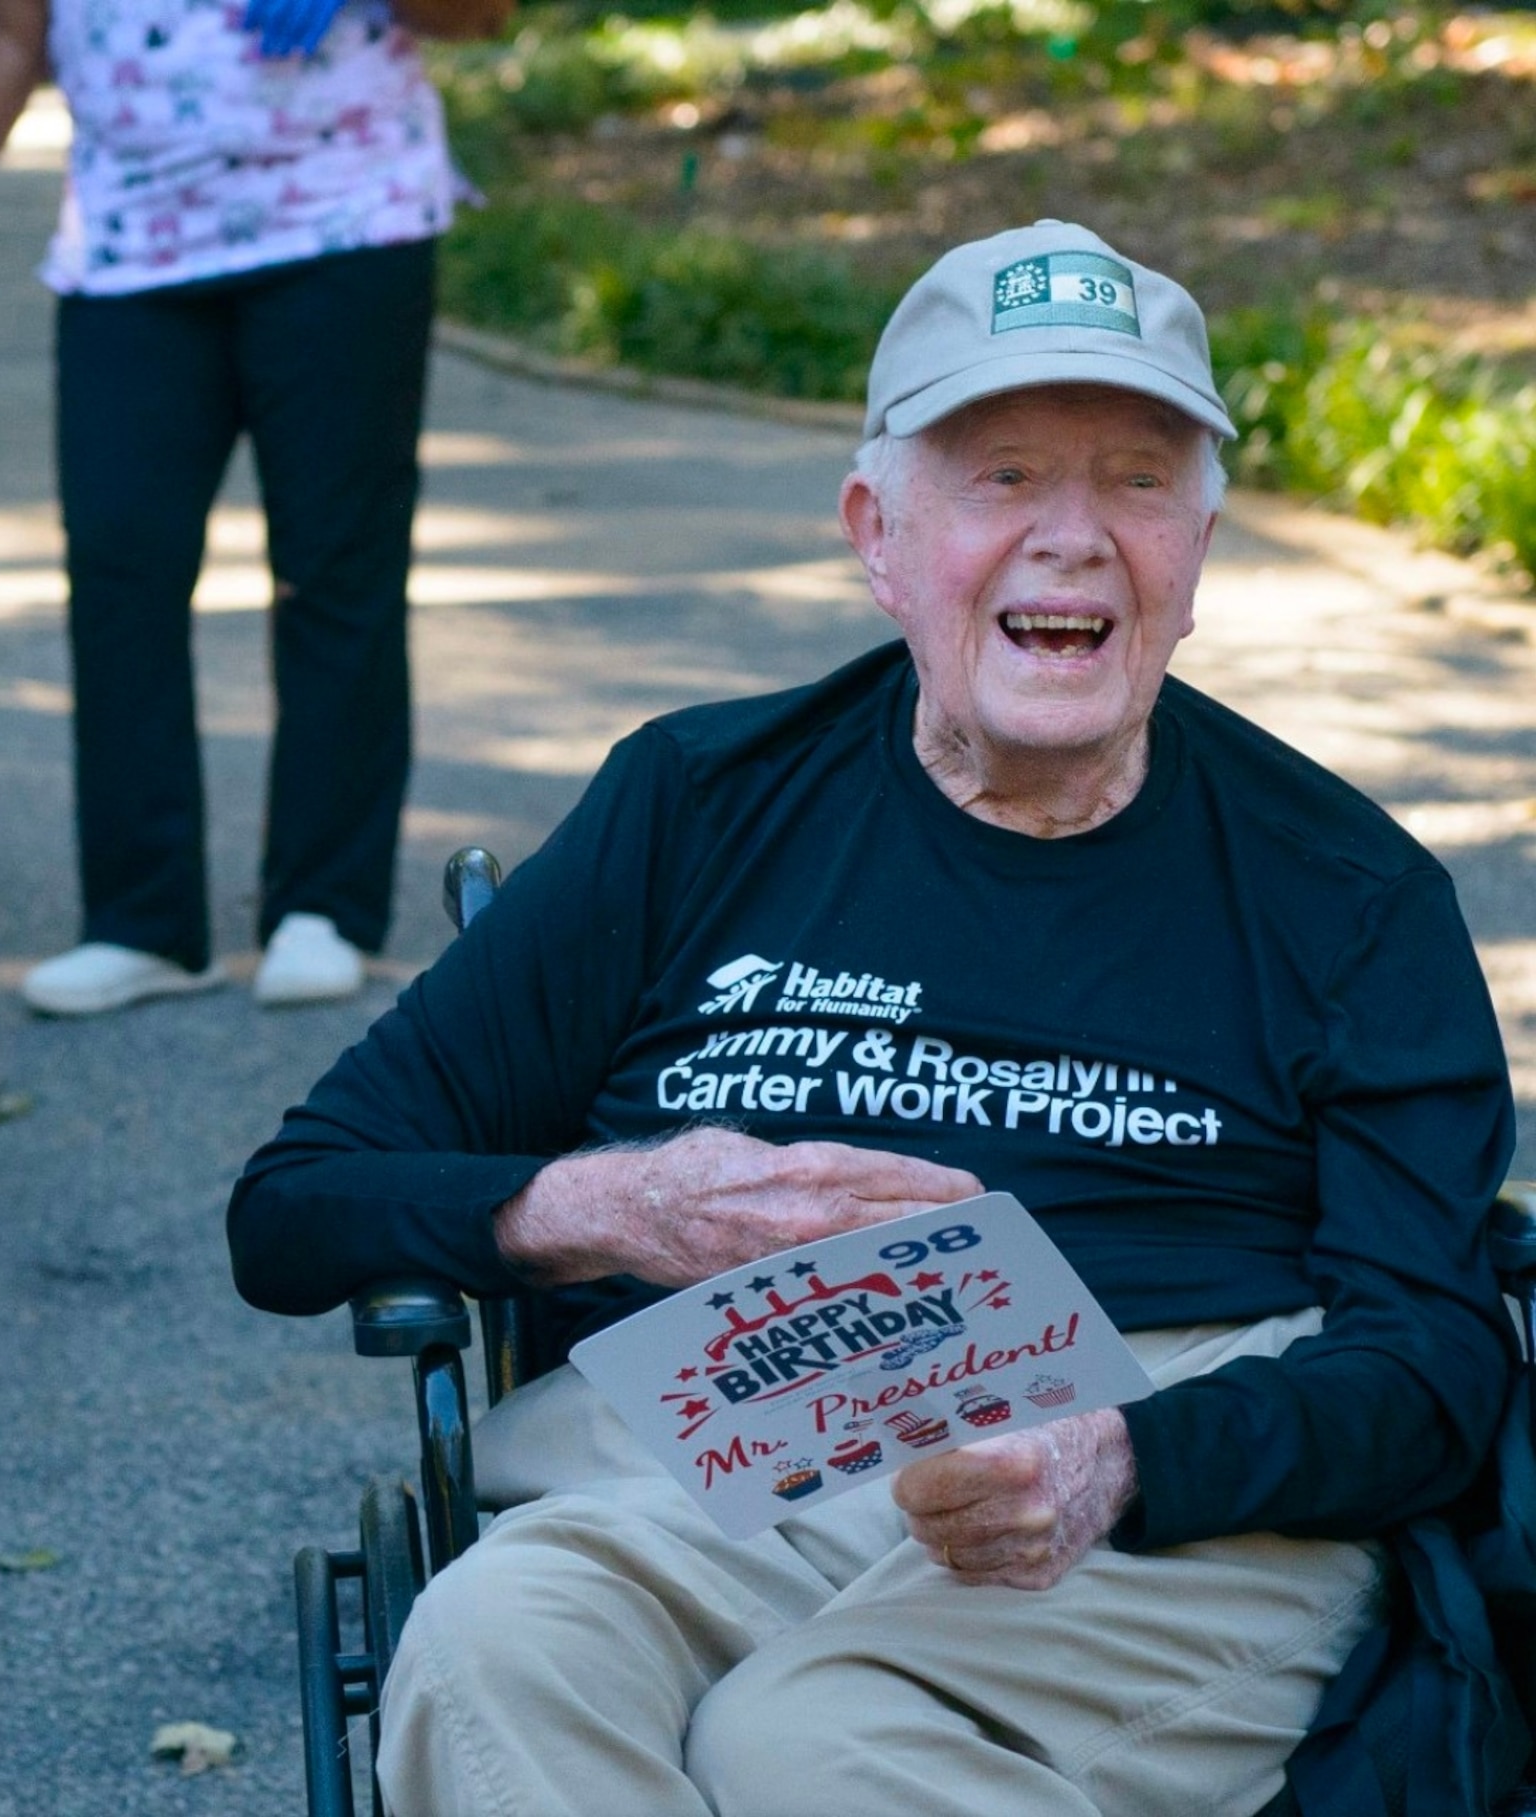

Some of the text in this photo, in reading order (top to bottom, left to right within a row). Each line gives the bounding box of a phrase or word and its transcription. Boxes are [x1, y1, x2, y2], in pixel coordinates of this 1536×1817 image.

[1078, 277, 1118, 306] 39
[783, 961, 923, 1007] Habitat
[775, 997, 912, 1025] for Humanity
[852, 1028, 898, 1073] &
[657, 1064, 1223, 1147] Carter Work Project
[878, 1224, 983, 1270] 98
[712, 1288, 968, 1405] BIRTHDAY
[734, 1292, 872, 1361] HAPPY
[695, 1436, 789, 1490] Mr.
[807, 1312, 1081, 1433] President!
